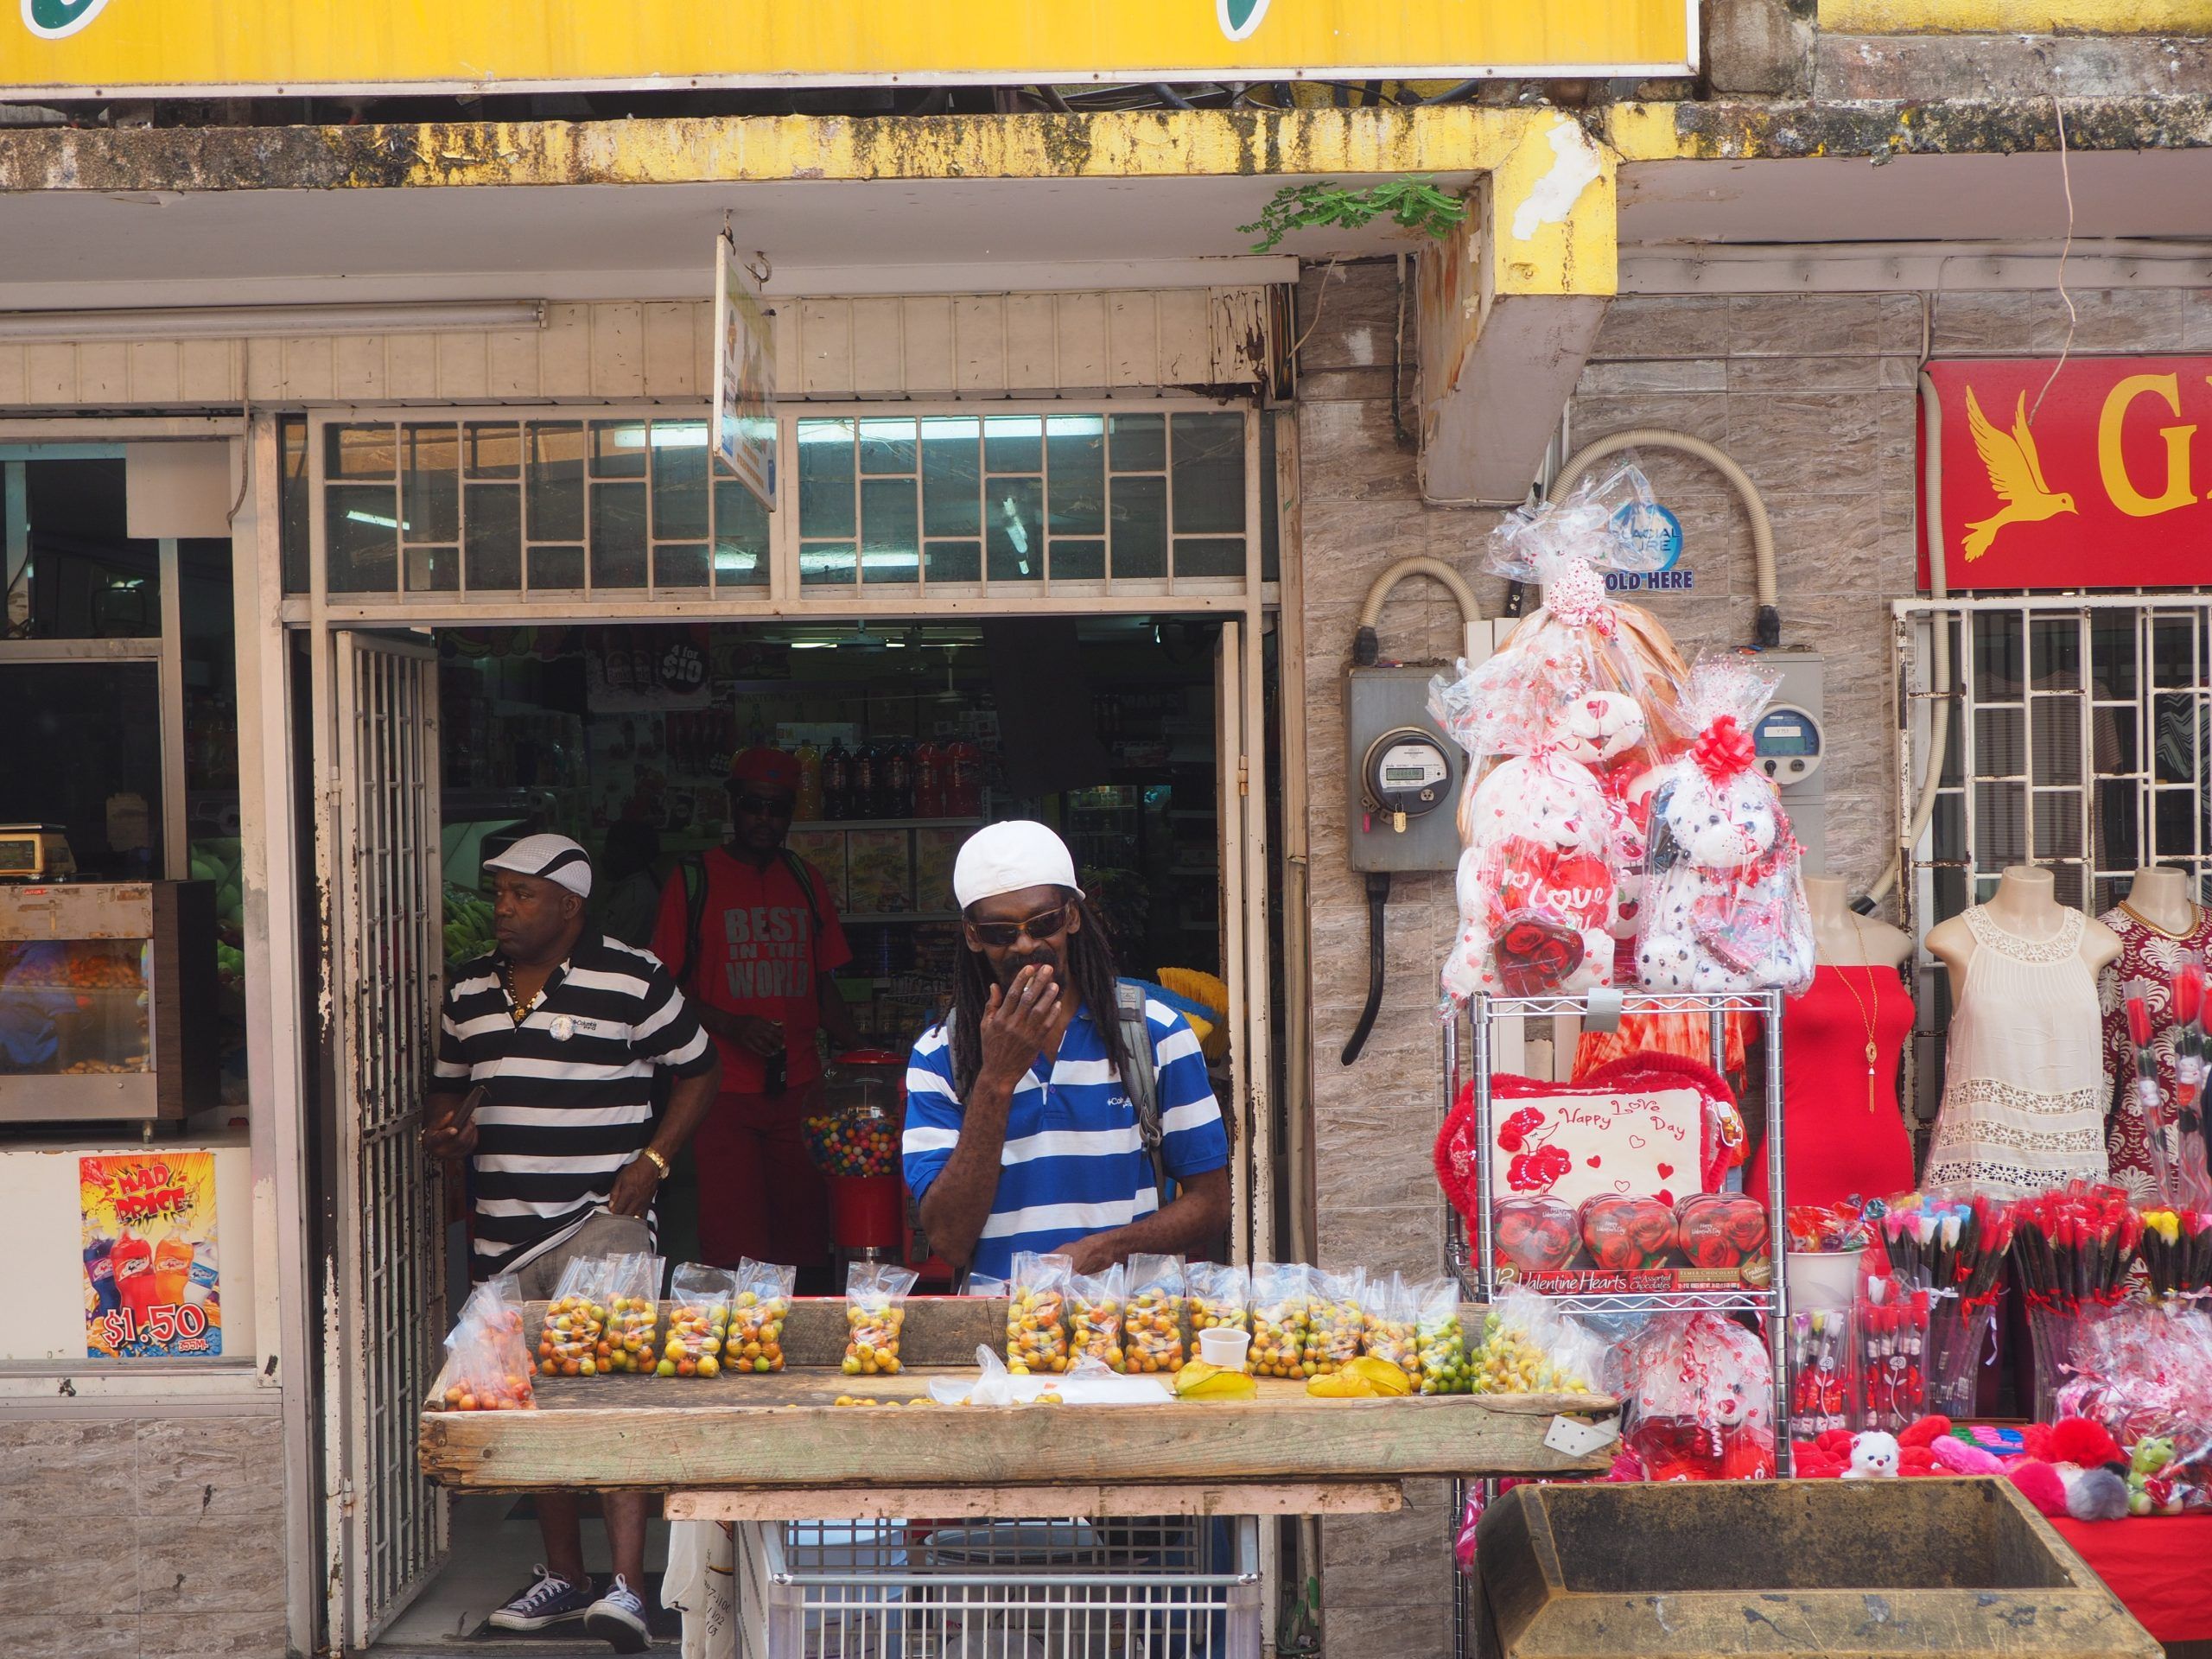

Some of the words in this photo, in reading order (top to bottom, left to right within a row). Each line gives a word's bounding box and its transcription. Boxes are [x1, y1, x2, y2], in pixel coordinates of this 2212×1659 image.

[1605, 573, 1641, 590] OLD
[1648, 571, 1693, 588] HERE
[671, 645, 679, 656] 4
[683, 646, 698, 659] for
[663, 655, 702, 683] $10
[724, 907, 808, 944] BEST
[729, 944, 758, 960] IN
[765, 944, 806, 958] THE
[725, 961, 810, 999] WORLD
[1559, 1108, 1611, 1130] Happy
[1649, 1116, 1686, 1141] Day
[116, 1164, 170, 1196] MAD
[114, 1186, 186, 1222] PRICE
[1495, 1268, 1515, 1285] 12
[1518, 1272, 1577, 1294] Valentine
[1580, 1271, 1627, 1293] Hearts
[1630, 1281, 1671, 1291] Chocolates
[1641, 1273, 1672, 1283] Assorted
[102, 1303, 206, 1348] $1.50
